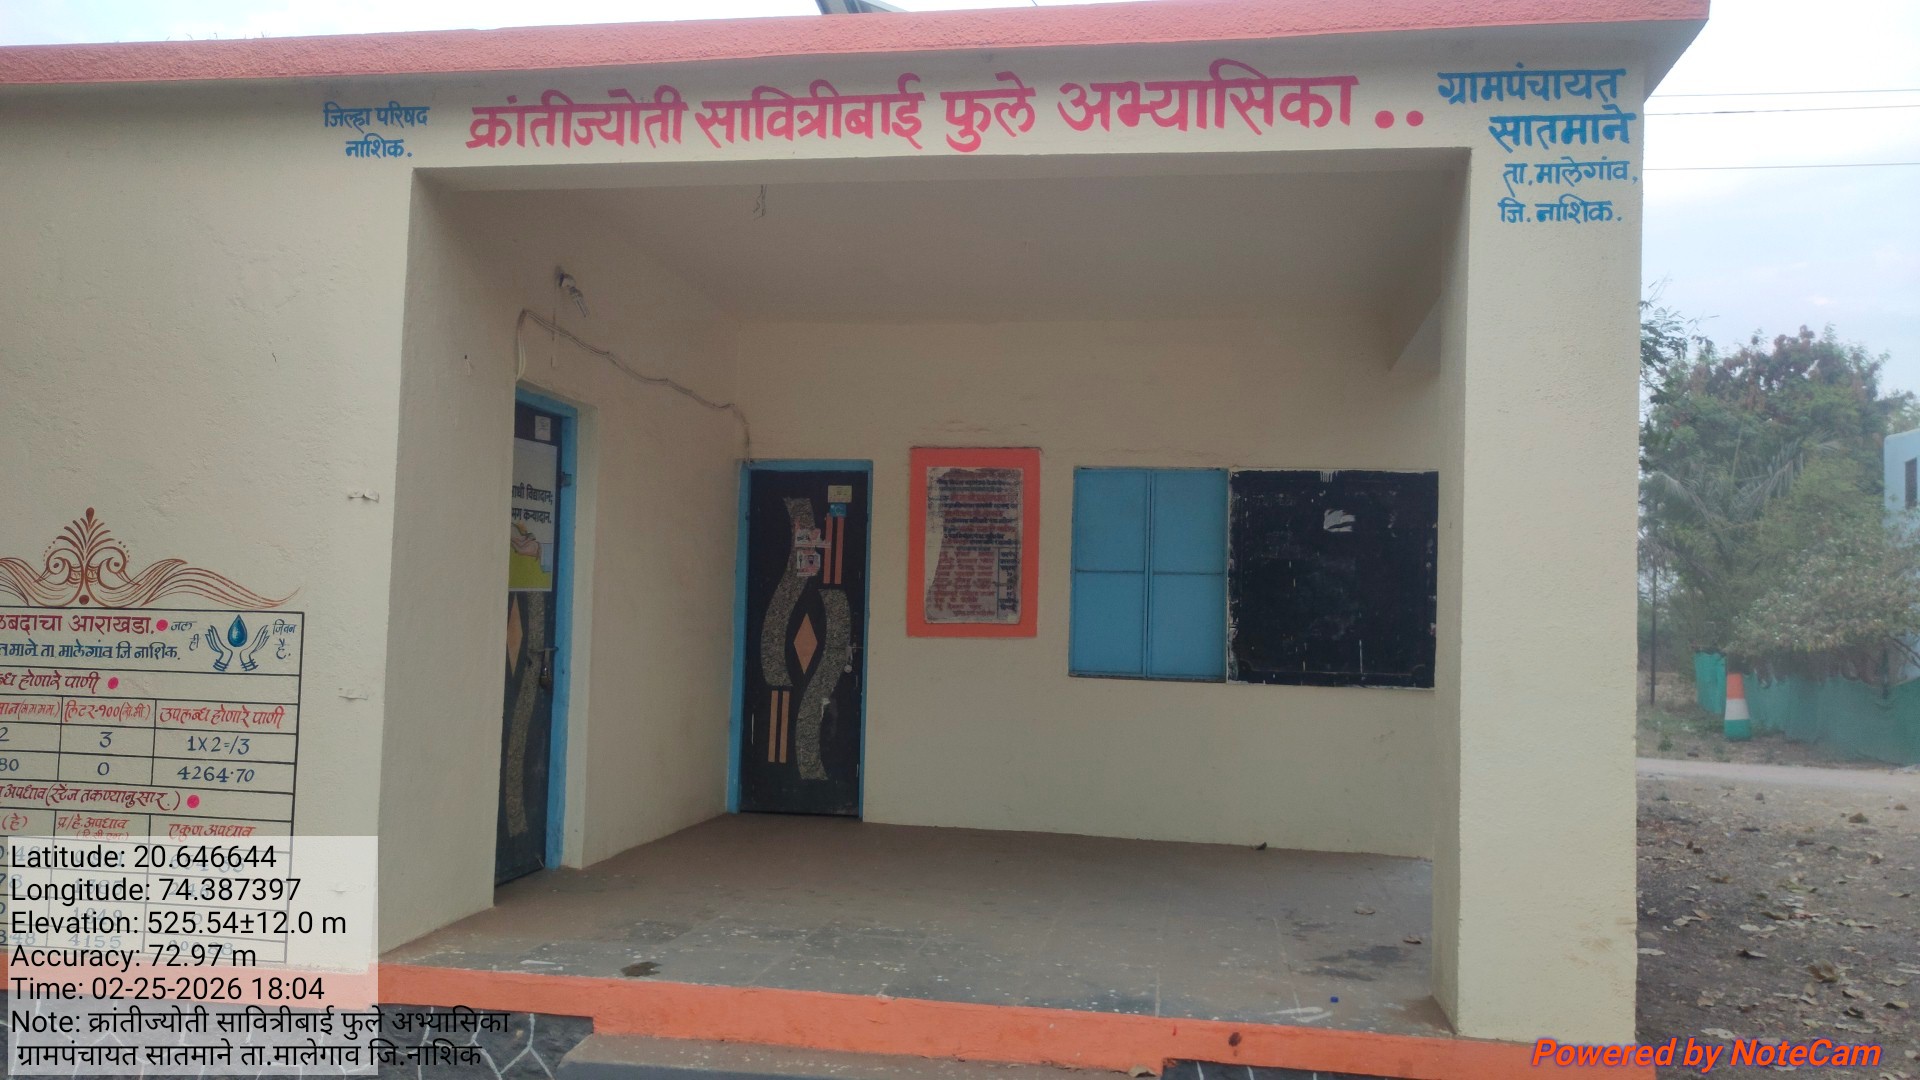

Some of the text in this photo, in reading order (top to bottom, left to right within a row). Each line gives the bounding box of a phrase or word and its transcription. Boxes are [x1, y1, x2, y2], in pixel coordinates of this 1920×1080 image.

[1437, 62, 1627, 104] ग्रामपंचायत
[322, 100, 430, 134] जिल्हा परिषद
[466, 84, 689, 150] क्रांतीज्योती
[694, 73, 926, 150] सावित्रीबाई
[940, 71, 1036, 152] फुले
[1057, 58, 1360, 135] अभ्यासिका
[1488, 103, 1637, 153] सातमाने
[64, 671, 101, 694] पाणी
[252, 705, 285, 729] पाणी
[99, 731, 113, 748] 3
